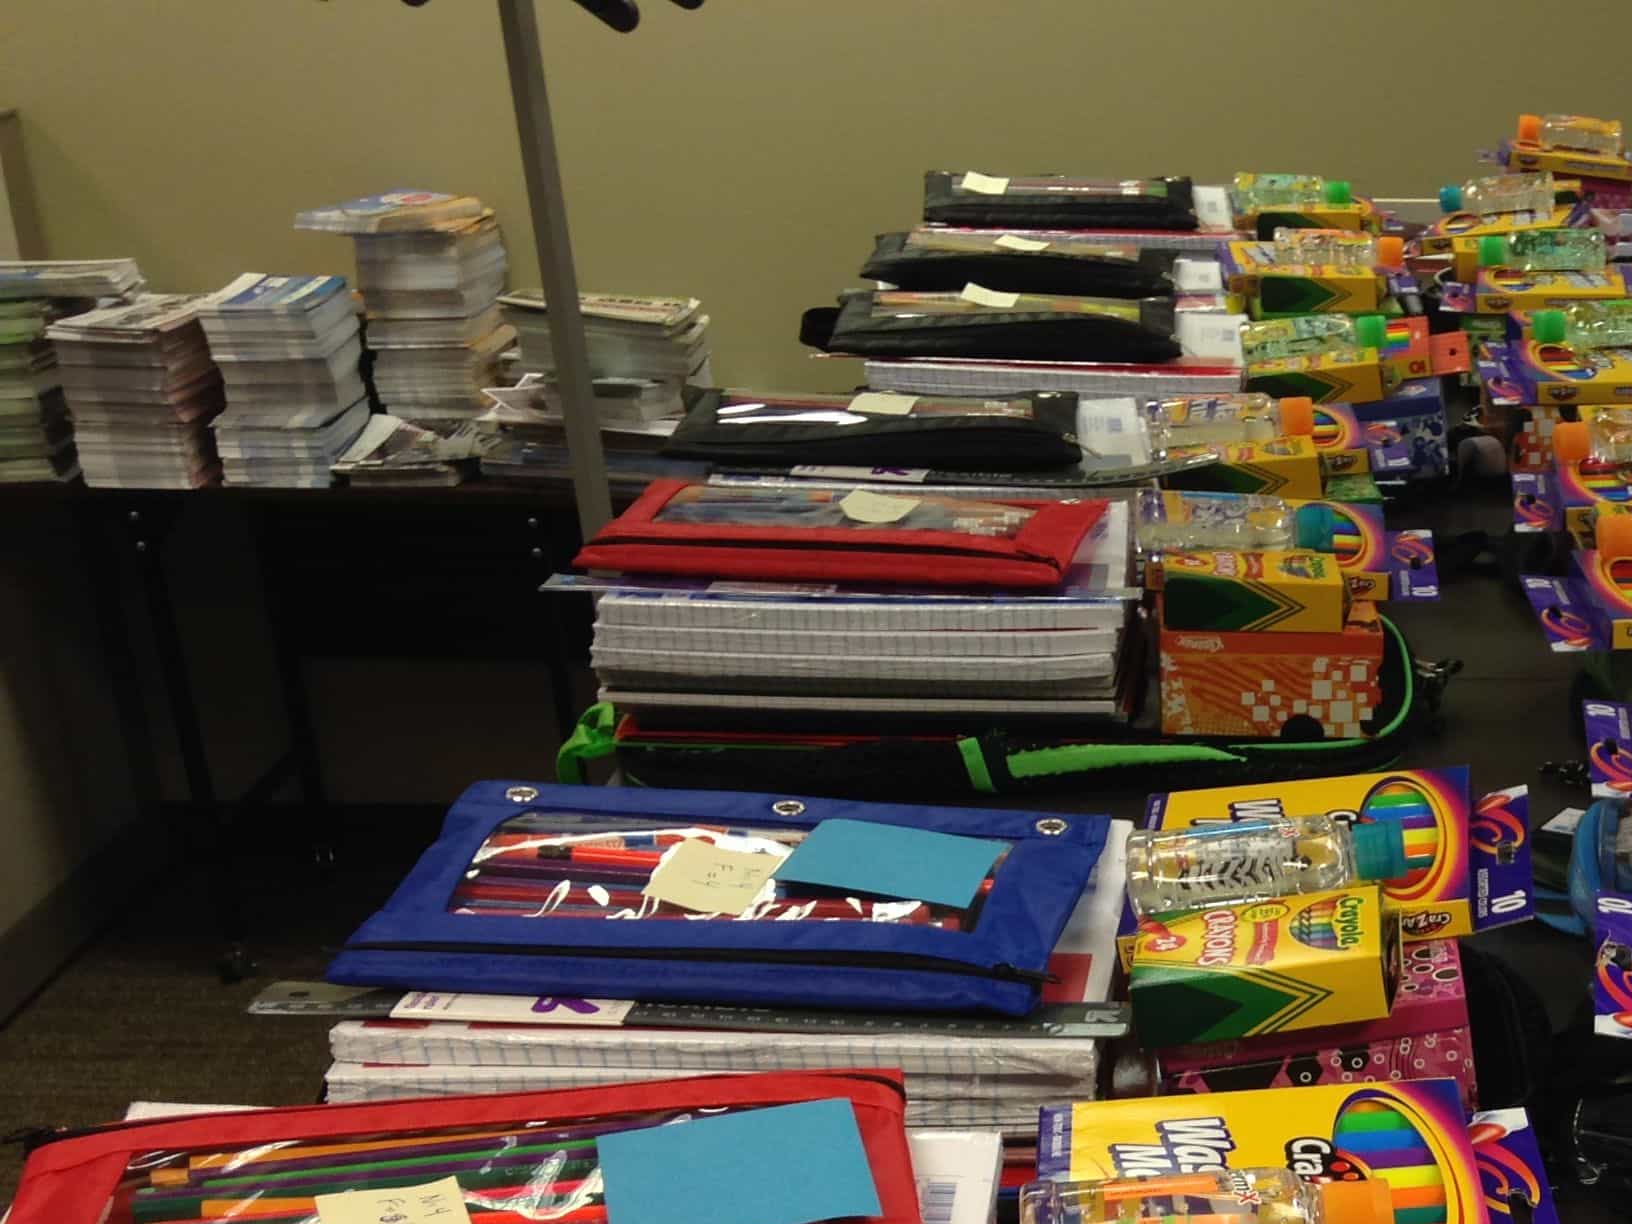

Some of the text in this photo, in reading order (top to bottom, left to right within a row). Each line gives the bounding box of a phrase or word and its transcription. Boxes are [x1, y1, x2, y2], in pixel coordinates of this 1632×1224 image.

[1339, 896, 1364, 947] Crayola
[1491, 889, 1527, 914] 10
[1197, 910, 1236, 966] CRAYONS
